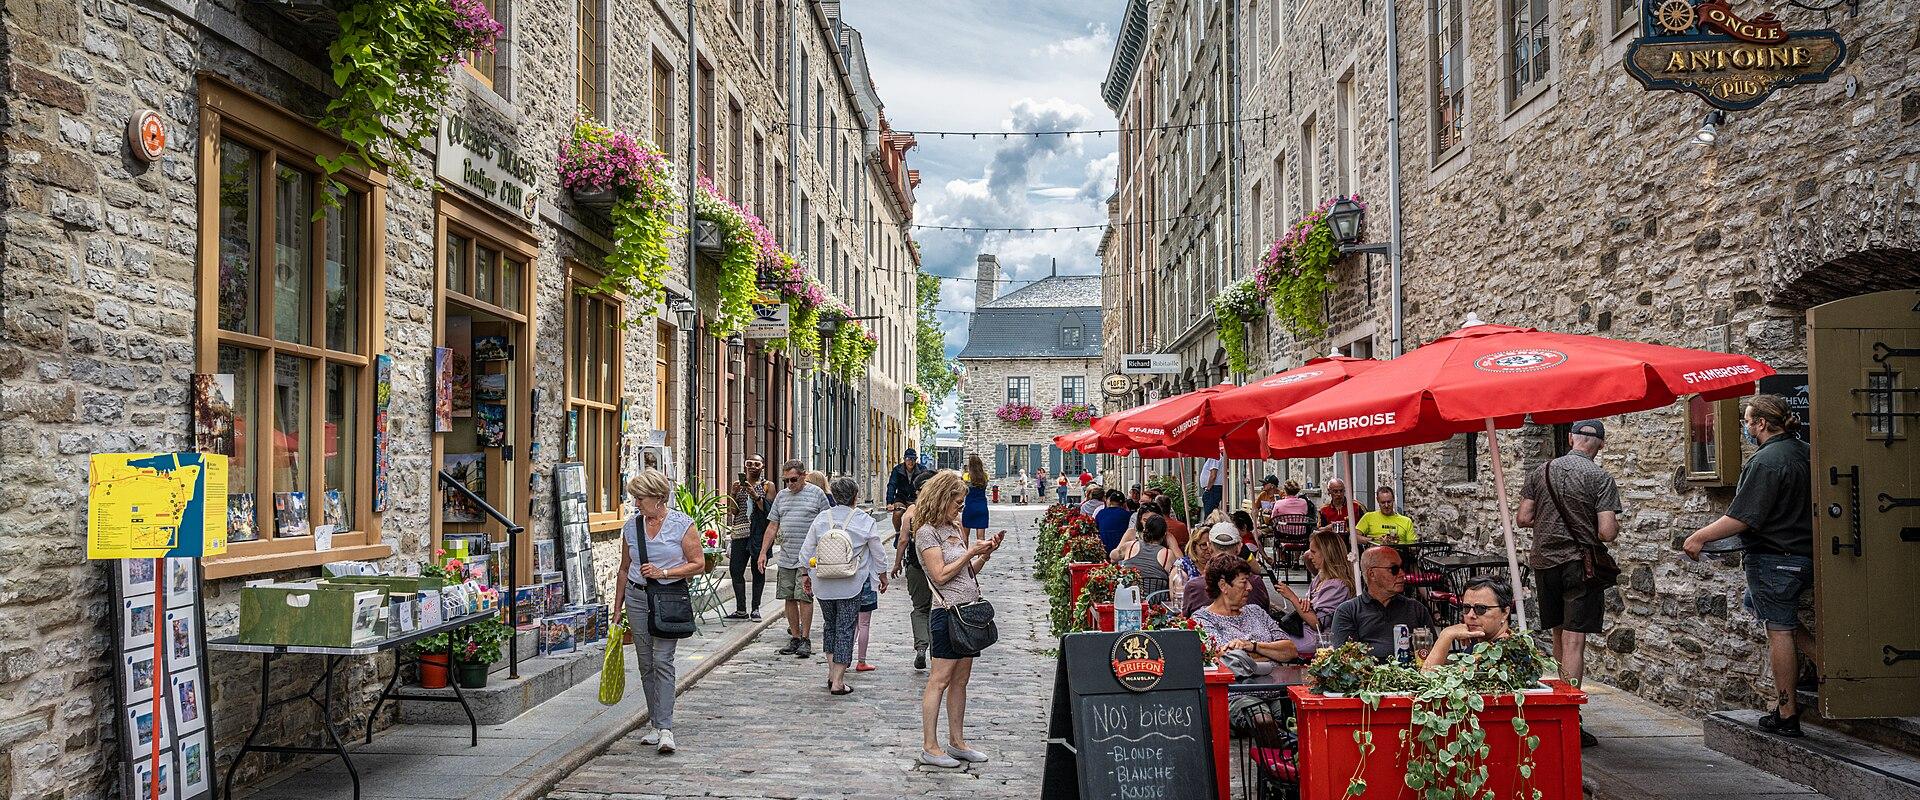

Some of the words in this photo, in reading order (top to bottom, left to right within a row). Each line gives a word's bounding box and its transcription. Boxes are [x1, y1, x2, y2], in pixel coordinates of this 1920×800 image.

[1709, 10, 1780, 40] ONCLE
[1664, 46, 1813, 73] ANTOINE
[1720, 79, 1758, 99] PUB
[497, 144, 537, 188] IMAGES
[463, 158, 497, 198] Boutique
[1128, 360, 1150, 368] Richard
[1682, 364, 1756, 384] ST-AMBROISE
[1110, 379, 1126, 387] LOFTS
[1783, 396, 1809, 405] HEVA
[1127, 426, 1165, 436] ST-AMBR
[1296, 411, 1396, 437] ST-AMBROISE
[1118, 662, 1161, 673] GRIFFON
